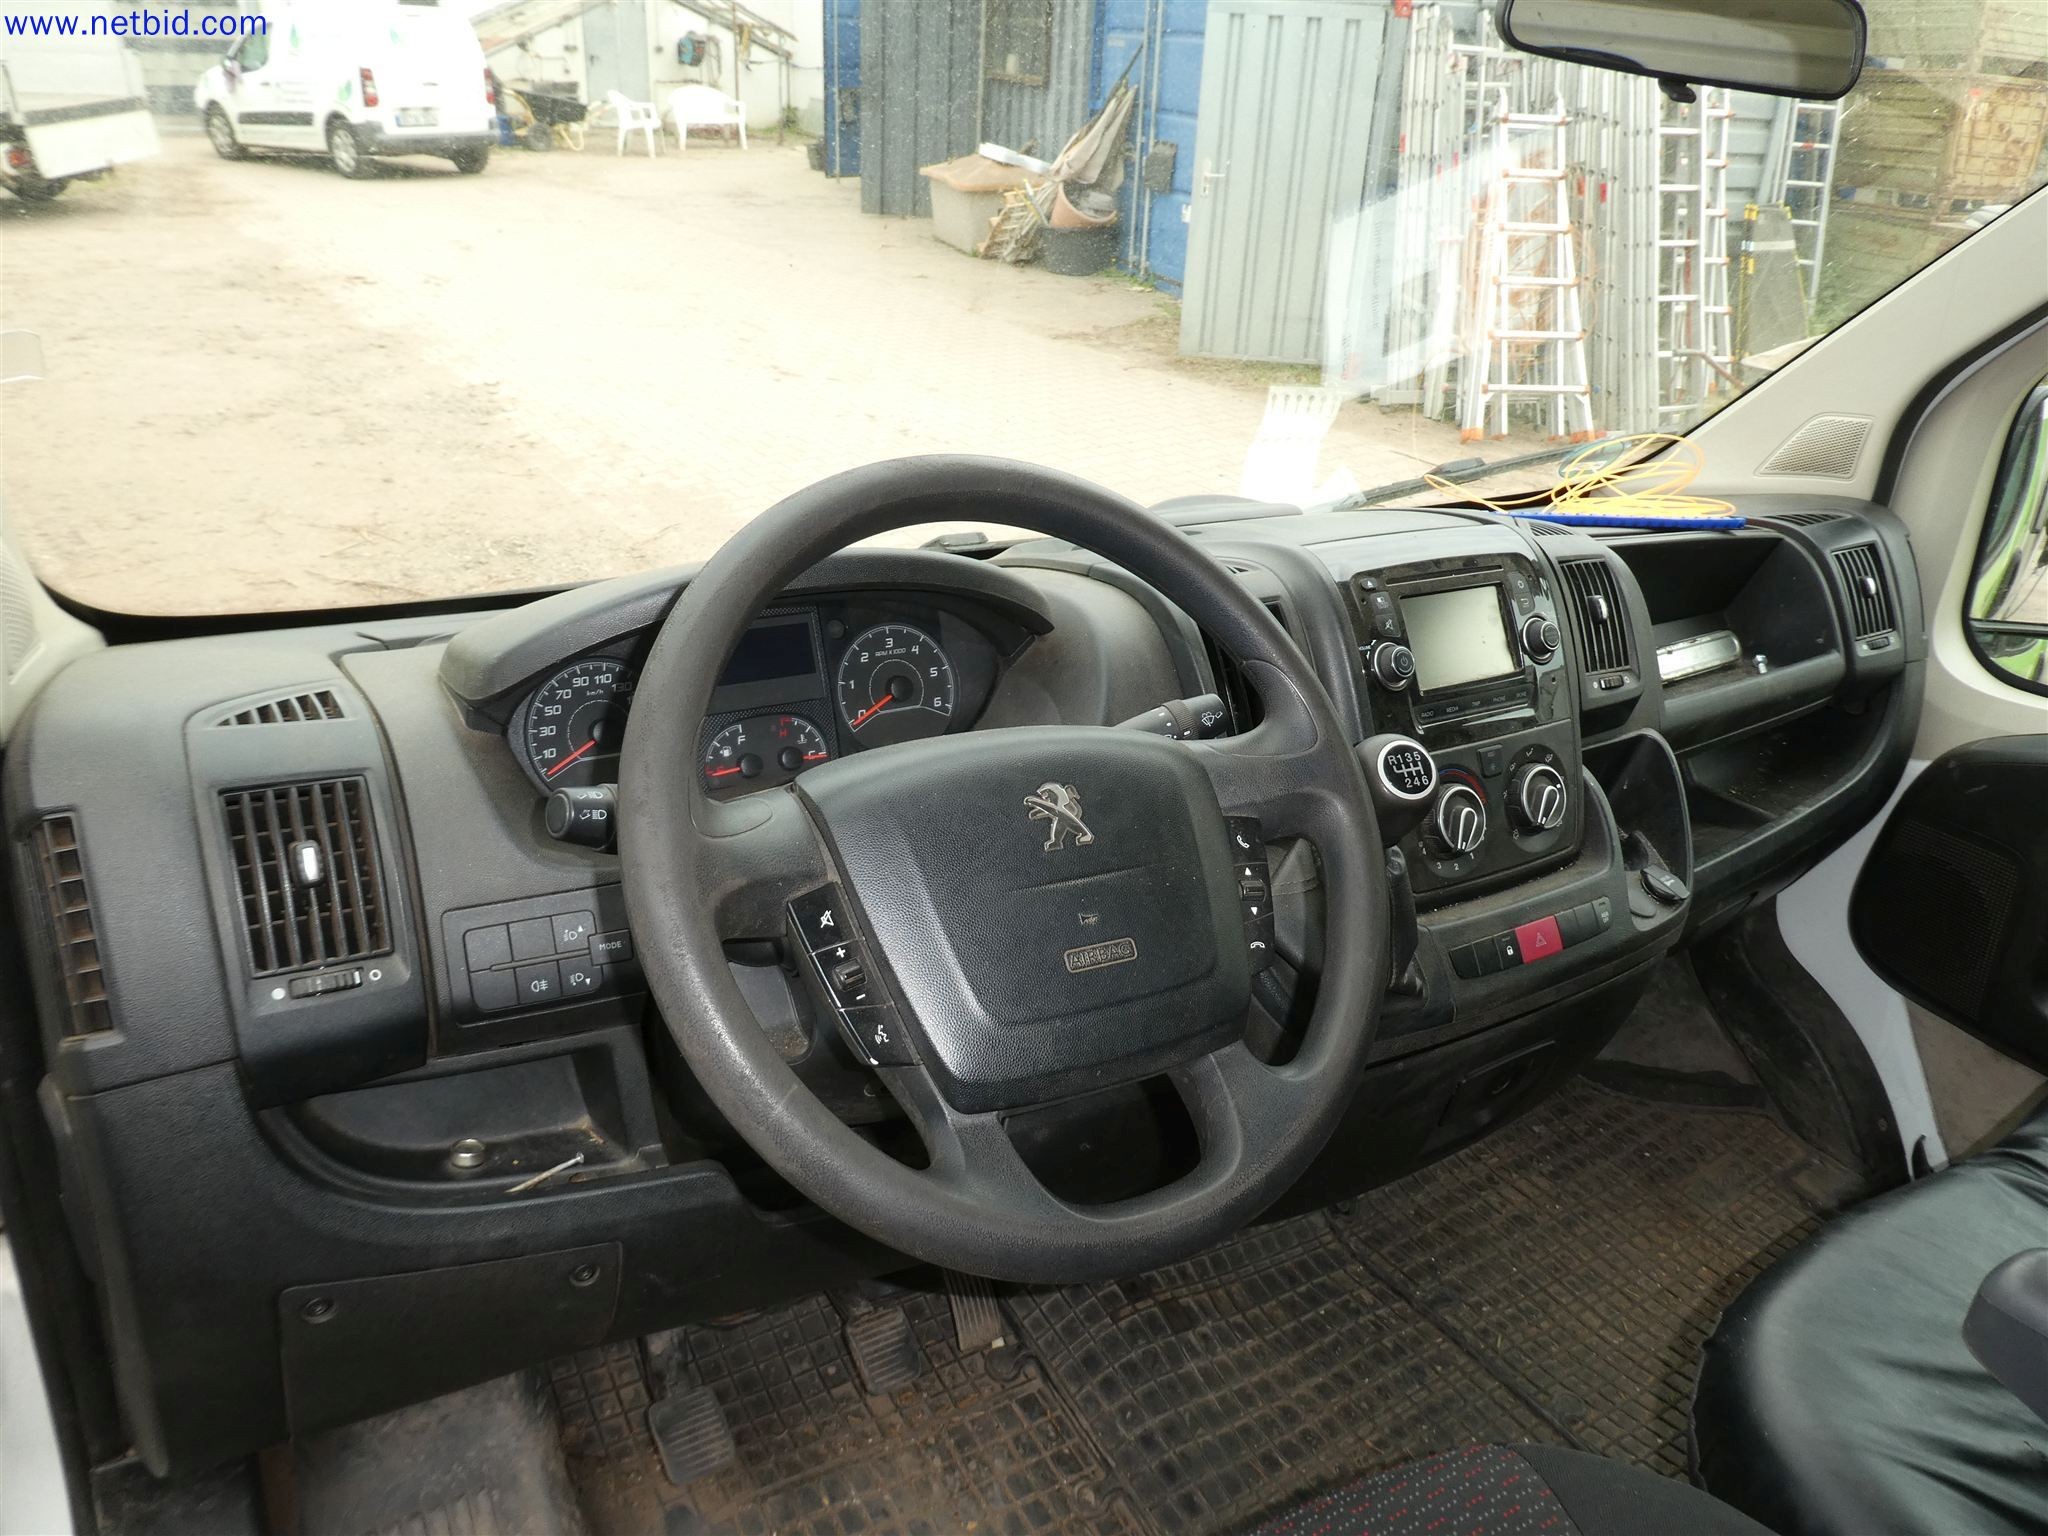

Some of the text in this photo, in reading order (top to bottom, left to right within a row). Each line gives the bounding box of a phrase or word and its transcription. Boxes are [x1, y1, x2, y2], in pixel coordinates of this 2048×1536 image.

[885, 638, 894, 648] 3
[911, 645, 919, 654] 4
[861, 652, 869, 662] 2
[930, 667, 938, 677] 5
[572, 676, 589, 687] 90
[594, 673, 612, 685] 110
[849, 680, 855, 689] 1
[555, 689, 572, 700] 70
[934, 697, 942, 707] 6
[544, 705, 561, 716] 50
[539, 726, 556, 737] 30
[738, 735, 746, 744] F
[542, 748, 556, 759] 10
[600, 940, 623, 951] MODE
[1070, 941, 1132, 969] AIRBAG
